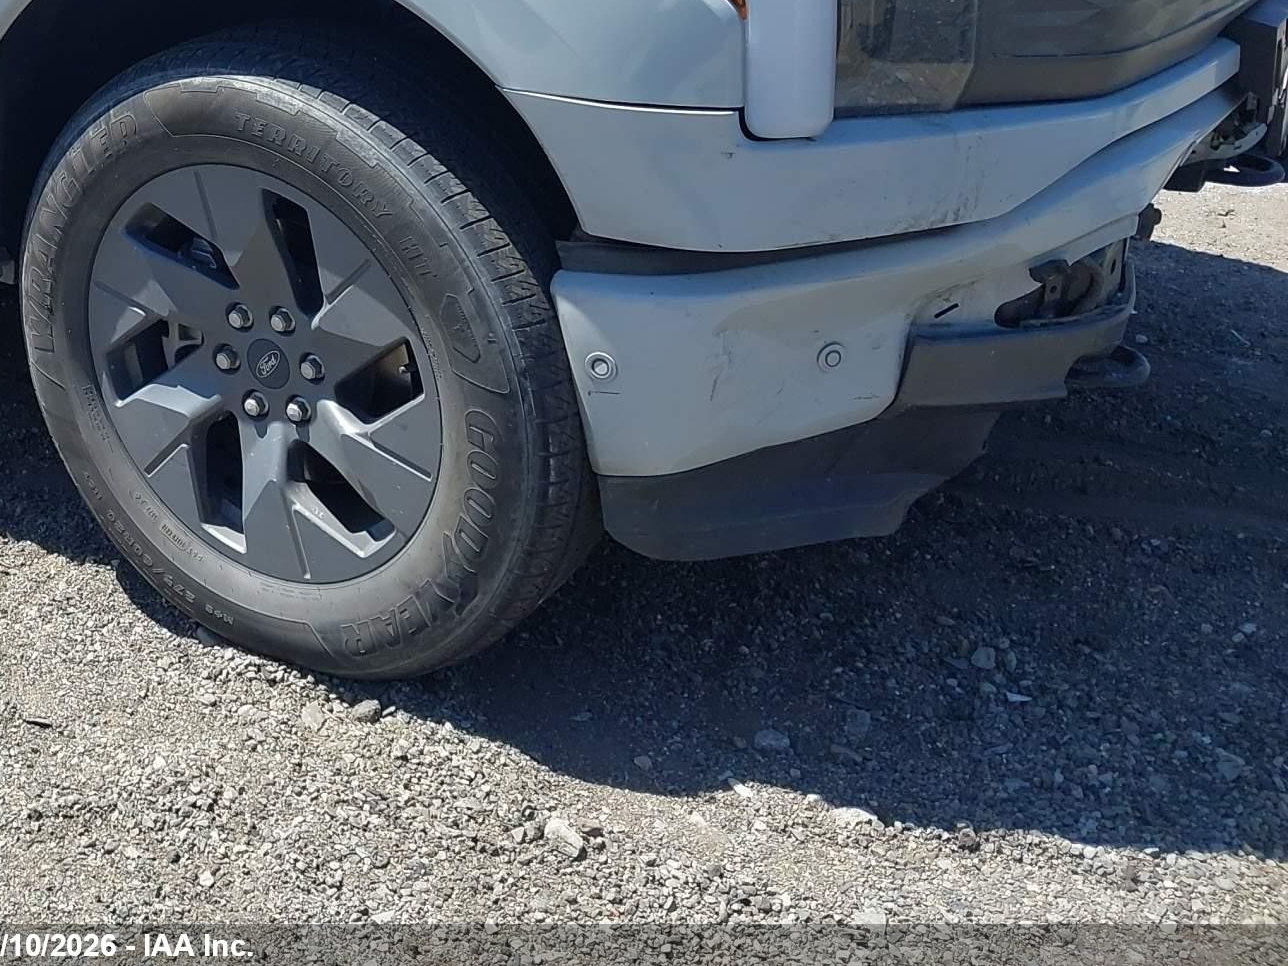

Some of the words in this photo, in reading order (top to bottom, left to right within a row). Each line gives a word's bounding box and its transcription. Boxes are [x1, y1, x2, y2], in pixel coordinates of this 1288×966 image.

[25, 109, 141, 356] WRANGLER
[234, 111, 393, 219] TERRITORY
[340, 407, 505, 656] GOODYEAR
